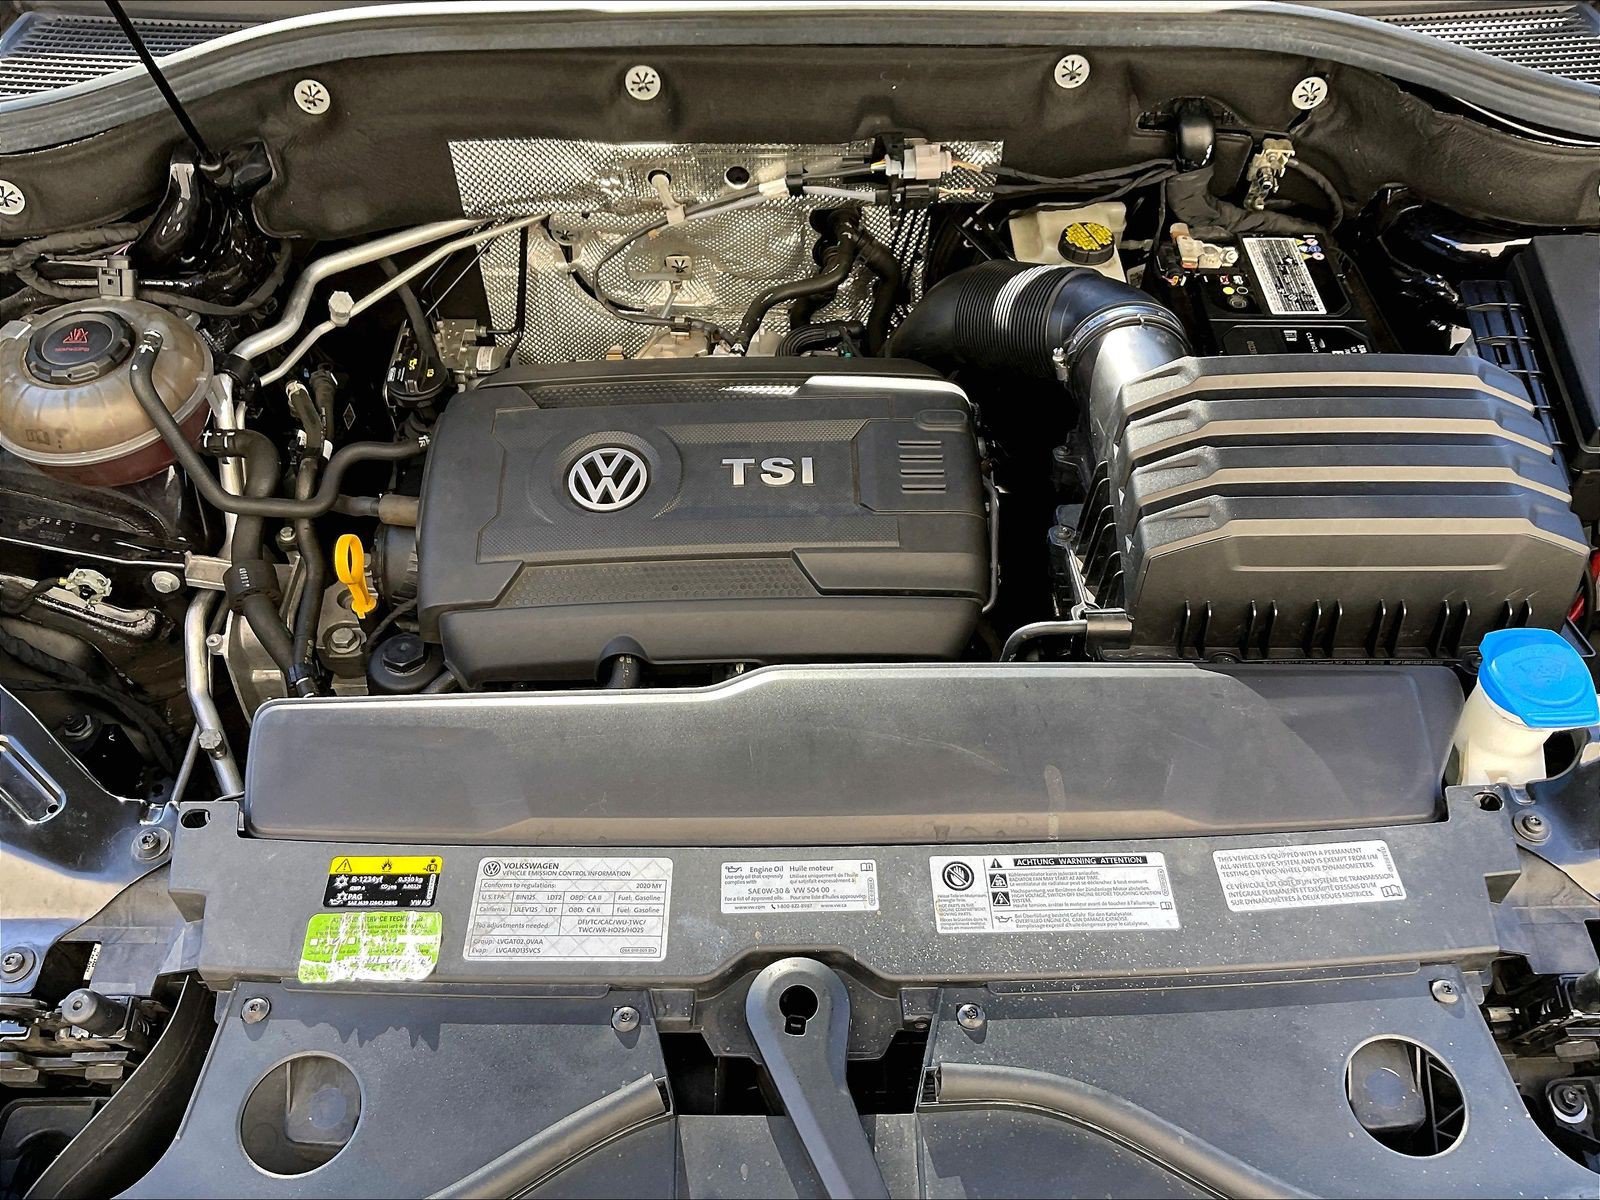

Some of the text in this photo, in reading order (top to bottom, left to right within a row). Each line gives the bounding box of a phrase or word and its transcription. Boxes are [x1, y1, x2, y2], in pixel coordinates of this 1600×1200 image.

[722, 457, 815, 487] TSI
[1268, 851, 1300, 859] EQUIPPED
[1324, 847, 1362, 855] PERMANENT
[1016, 856, 1143, 866] ACHTUNG WARNING ATTENTION
[503, 862, 560, 870] VOLKSWAGEN
[750, 866, 773, 874] Engine
[1222, 870, 1250, 878] TESTING
[1261, 867, 1302, 875] TWO-WHEEL
[1348, 873, 1394, 882] TRANSMISSION
[761, 887, 784, 895] 0W-30
[1321, 892, 1342, 900] ROUES
[486, 922, 525, 930] adjustments
